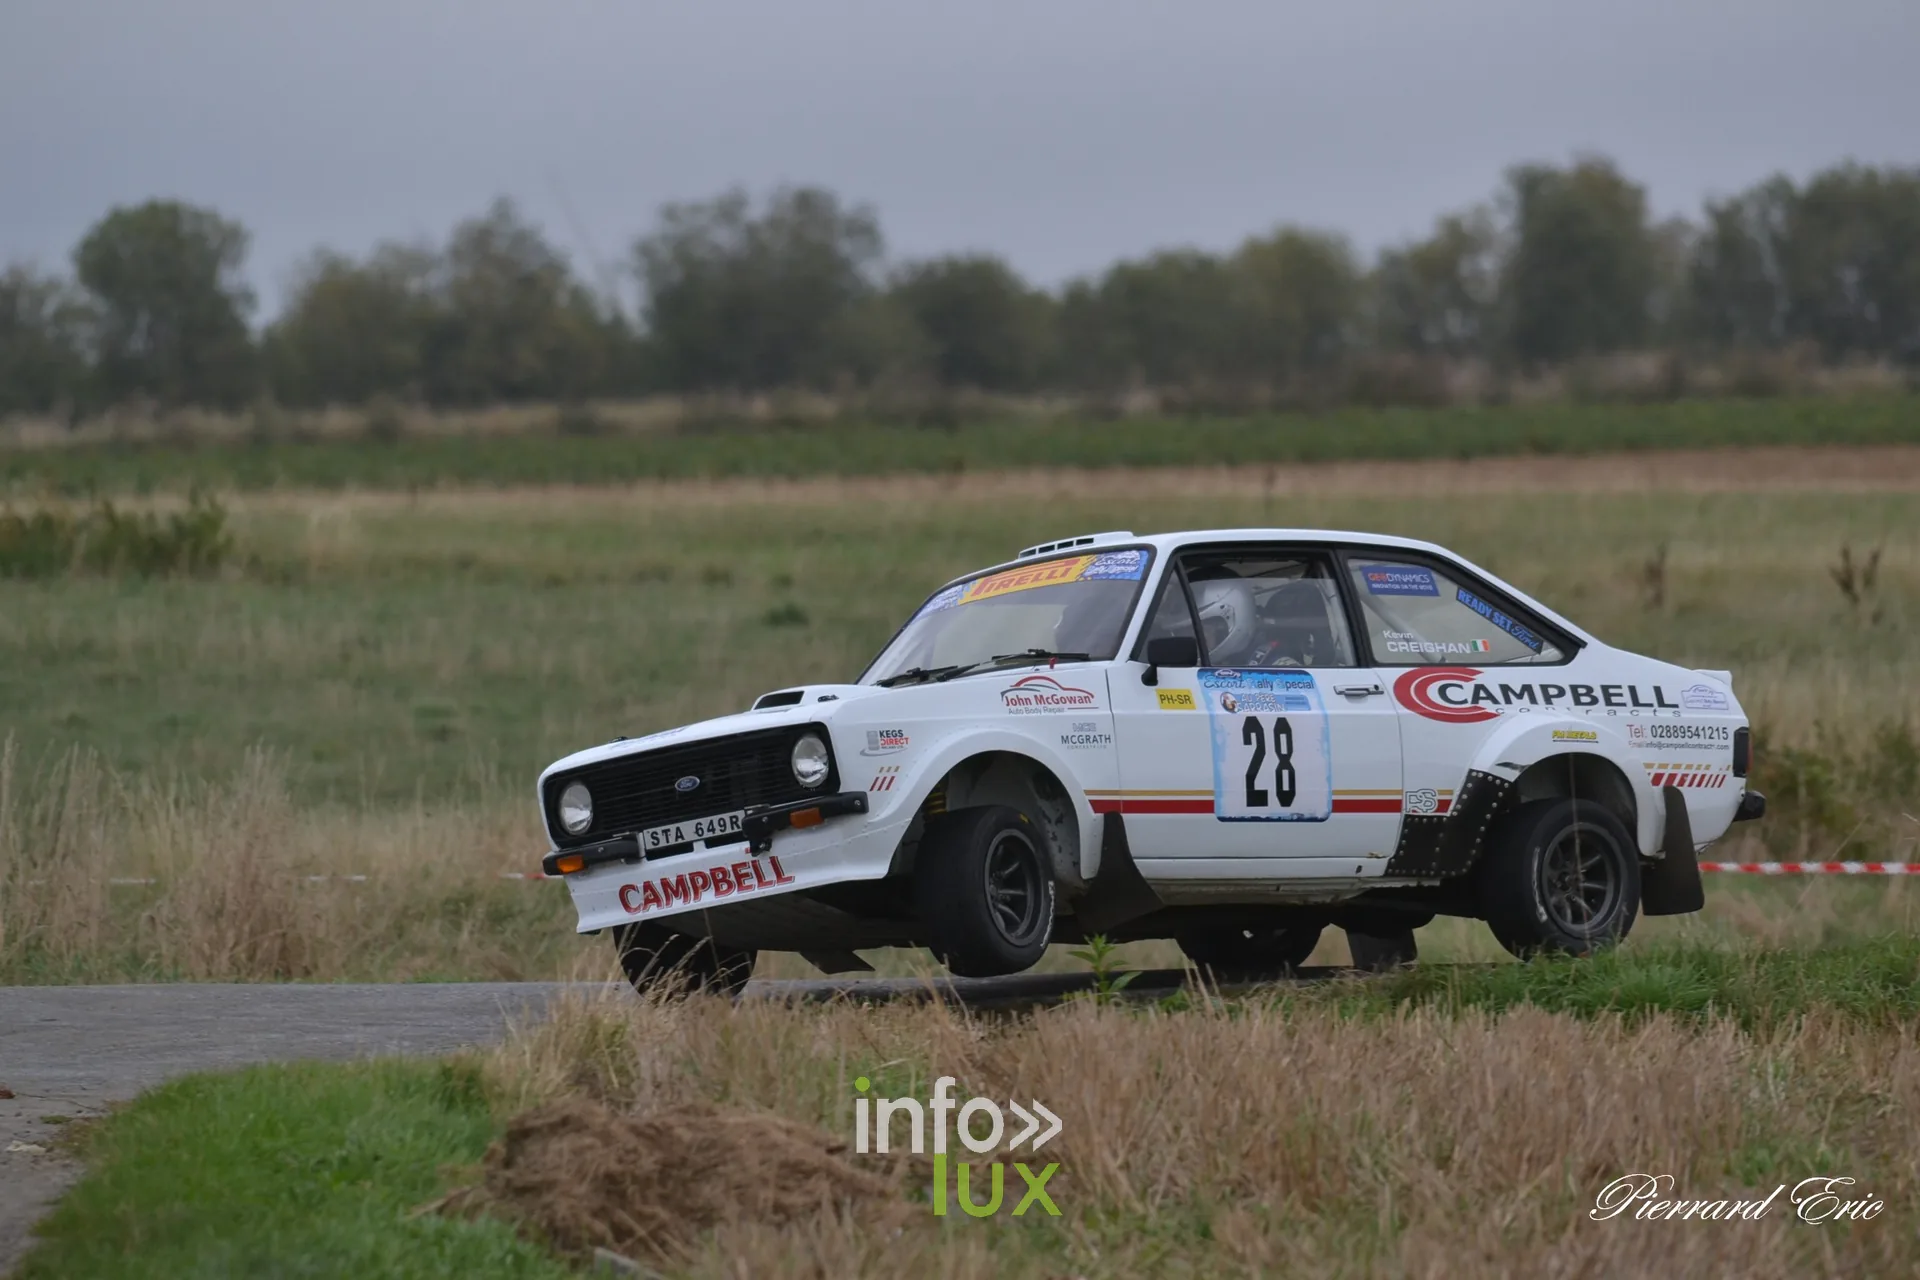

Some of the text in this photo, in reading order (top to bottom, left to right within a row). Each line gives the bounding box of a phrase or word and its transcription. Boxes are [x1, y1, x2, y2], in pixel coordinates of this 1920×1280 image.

[971, 558, 1081, 597] PIRELLI
[1458, 589, 1493, 618] READY
[1492, 611, 1513, 632] SET
[1383, 630, 1414, 639] Kevin
[1386, 641, 1471, 654] CREIGHAN
[1203, 673, 1245, 688] Escort
[1005, 693, 1092, 707] John McGowan
[1159, 694, 1192, 705] PH-SR
[1438, 683, 1679, 709] CAMPBELL
[1025, 706, 1042, 715] Body
[1043, 706, 1065, 714] Repair
[879, 729, 904, 738] KEGS
[1626, 724, 1729, 740] Tel: 02889541215
[880, 737, 909, 746] DIRECT
[1061, 734, 1111, 745] MCGRATH
[1242, 716, 1296, 807] 28
[651, 815, 741, 847] STA 649R
[618, 856, 796, 916] CAMPBELL
